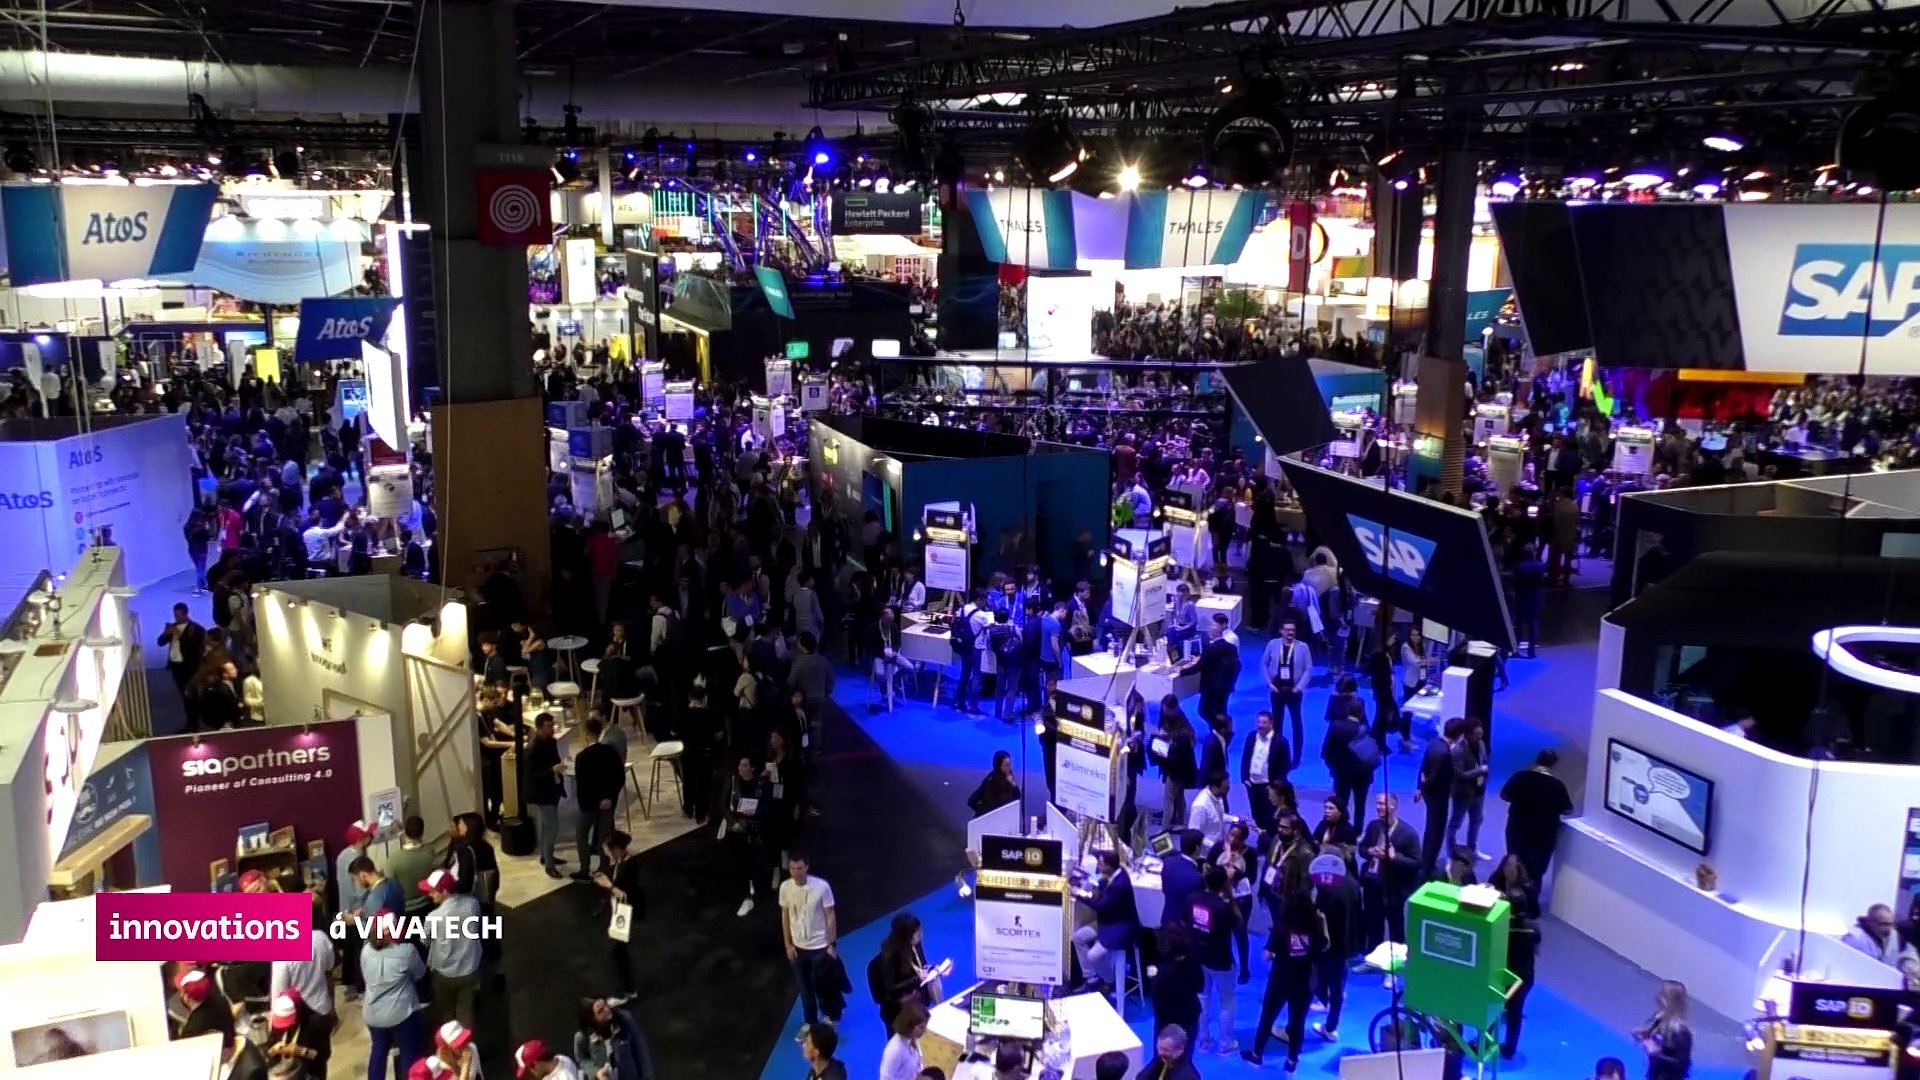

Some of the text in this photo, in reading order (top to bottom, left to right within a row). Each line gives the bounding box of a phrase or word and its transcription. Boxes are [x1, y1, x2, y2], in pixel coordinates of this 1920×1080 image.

[1000, 219, 1042, 233] THALES
[1169, 220, 1224, 235] THALES
[1354, 526, 1425, 579] SAP
[184, 769, 333, 793] Pioneer of Consulting 4.0
[995, 927, 1041, 937] SCORTEX
